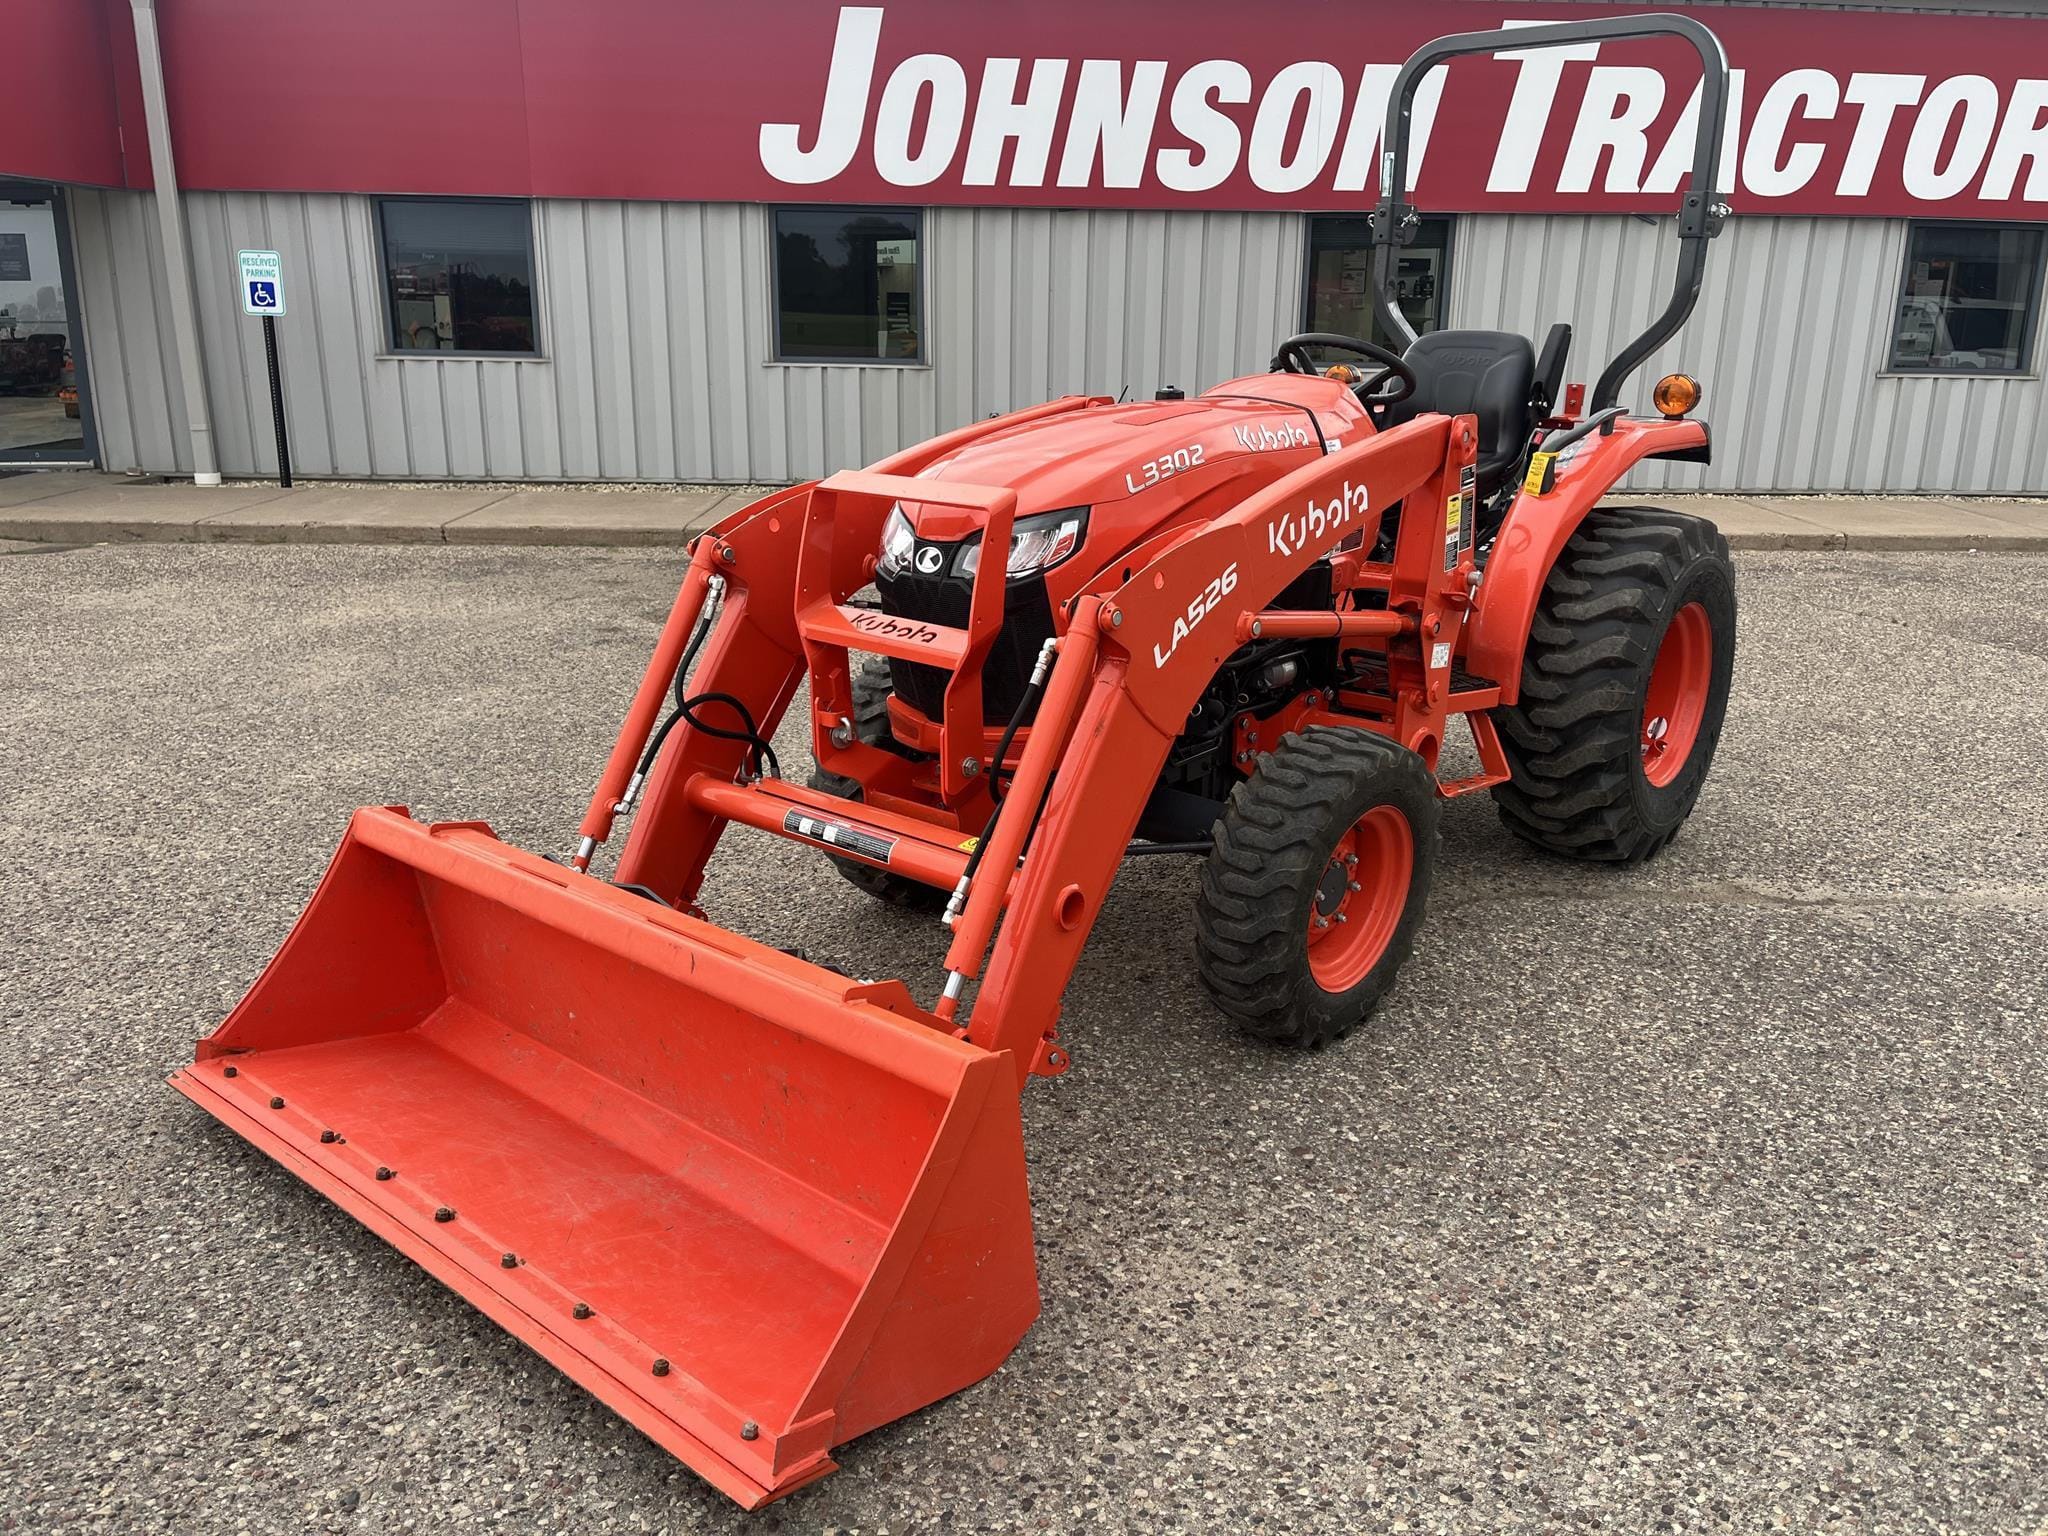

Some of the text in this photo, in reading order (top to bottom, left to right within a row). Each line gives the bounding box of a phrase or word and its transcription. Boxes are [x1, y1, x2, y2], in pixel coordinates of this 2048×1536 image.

[759, 6, 1450, 193] JOHNSON
[241, 257, 278, 267] RESERVED
[246, 268, 276, 278] PARKING
[1233, 421, 1309, 452] Kubota
[1125, 444, 1206, 495] L3302
[1268, 480, 1369, 557] Kubota
[850, 613, 938, 643] Kubota
[1153, 561, 1238, 669] LA526
